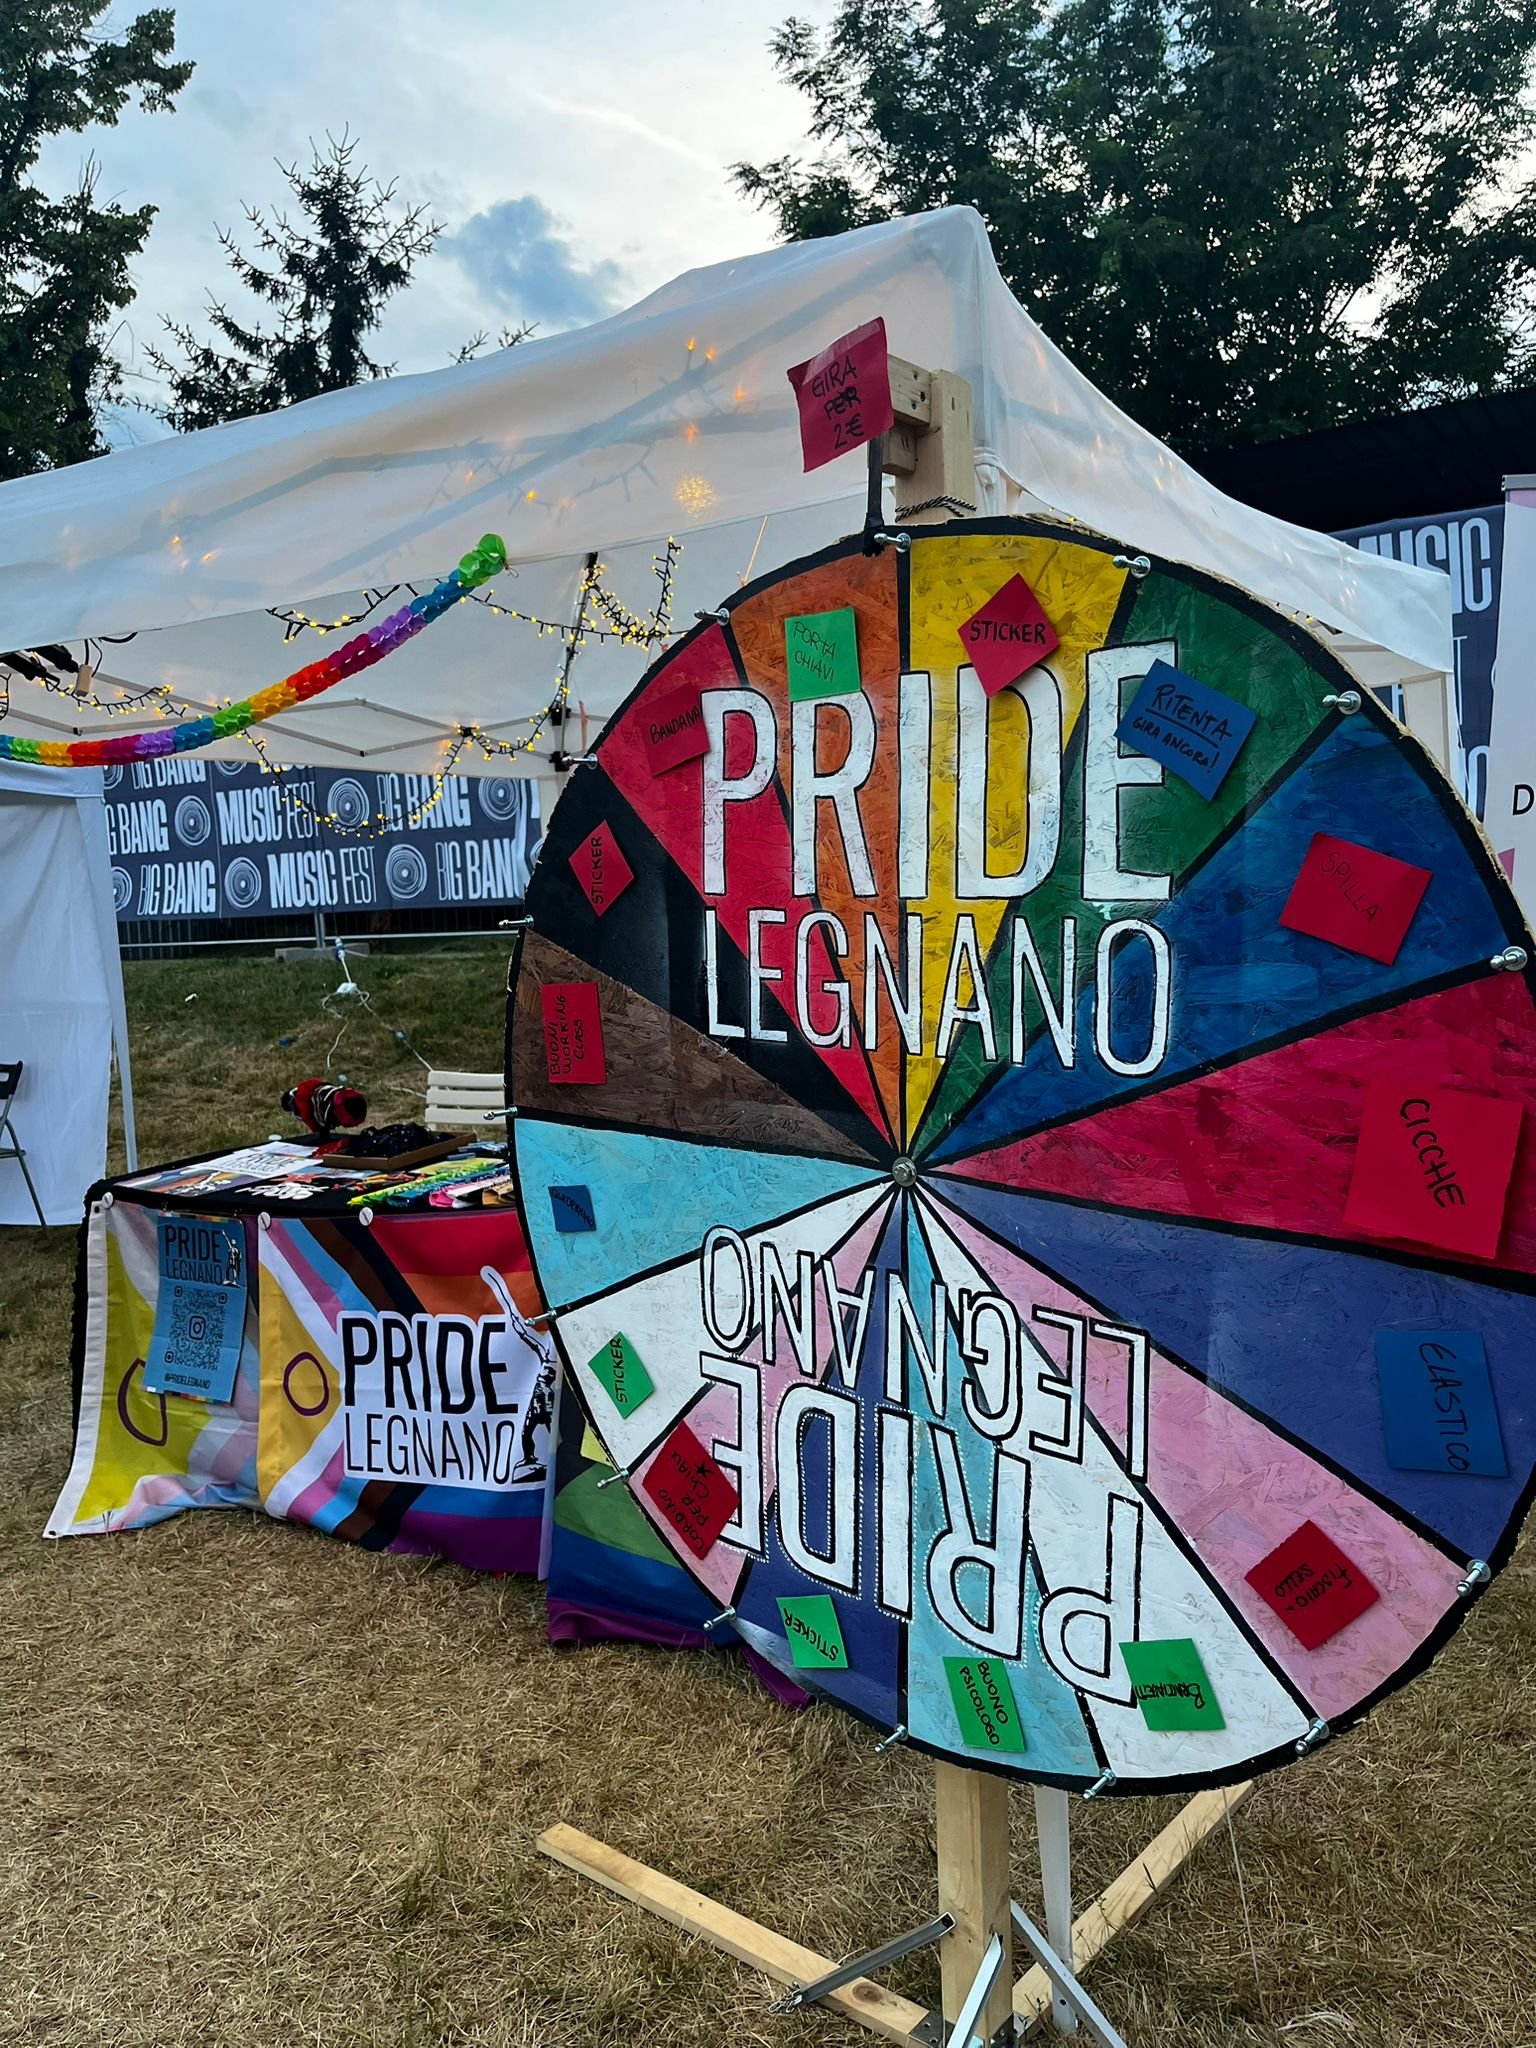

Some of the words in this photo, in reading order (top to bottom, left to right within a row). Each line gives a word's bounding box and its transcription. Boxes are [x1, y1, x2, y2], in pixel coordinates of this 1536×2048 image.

[812, 355, 858, 398] GIRA
[824, 386, 861, 421] PER
[834, 413, 864, 450] 2€
[794, 621, 837, 660] PORTA
[969, 619, 1047, 645] STICKER
[795, 651, 836, 683] CHIAVI
[650, 708, 701, 744] BANDANA
[1153, 683, 1233, 742] RITENTA
[700, 640, 1178, 900] PRIDE
[1133, 715, 1159, 741] GIRA
[1162, 731, 1219, 775] ANCORA!
[117, 799, 169, 855] BANG
[216, 787, 283, 845] MUSIC
[285, 781, 319, 839] FEST
[376, 773, 403, 833] BIG
[404, 773, 471, 831] BANG
[137, 864, 160, 915] BIG
[162, 860, 216, 914] BANG
[267, 847, 336, 908] MUSIC
[340, 845, 376, 904] FEST
[434, 841, 463, 901] BIG
[591, 835, 604, 905] STICKER
[1321, 851, 1379, 926] SPILLA
[702, 908, 1173, 1078] LEGNANO
[573, 1020, 584, 1060] CLASS
[1400, 1098, 1466, 1209] CICCHE
[164, 1224, 222, 1263] PRIDE
[165, 1258, 223, 1285] LEGNANO
[164, 1373, 211, 1389] @PRIDELEGNANO
[341, 1318, 518, 1415] PRIDE
[610, 1338, 628, 1403] STICKER
[701, 1224, 1151, 1482] LEGNANO
[1419, 1343, 1470, 1471] ELASTICO
[345, 1412, 516, 1485] LEGNANO
[681, 1493, 709, 1526] PER
[700, 1351, 1144, 1708] PRIDE
[1274, 1563, 1315, 1598] SELLO
[783, 1607, 839, 1661] STICKER
[959, 1665, 1000, 1745] PSICOLOGO
[977, 1661, 1008, 1725] BUONO
